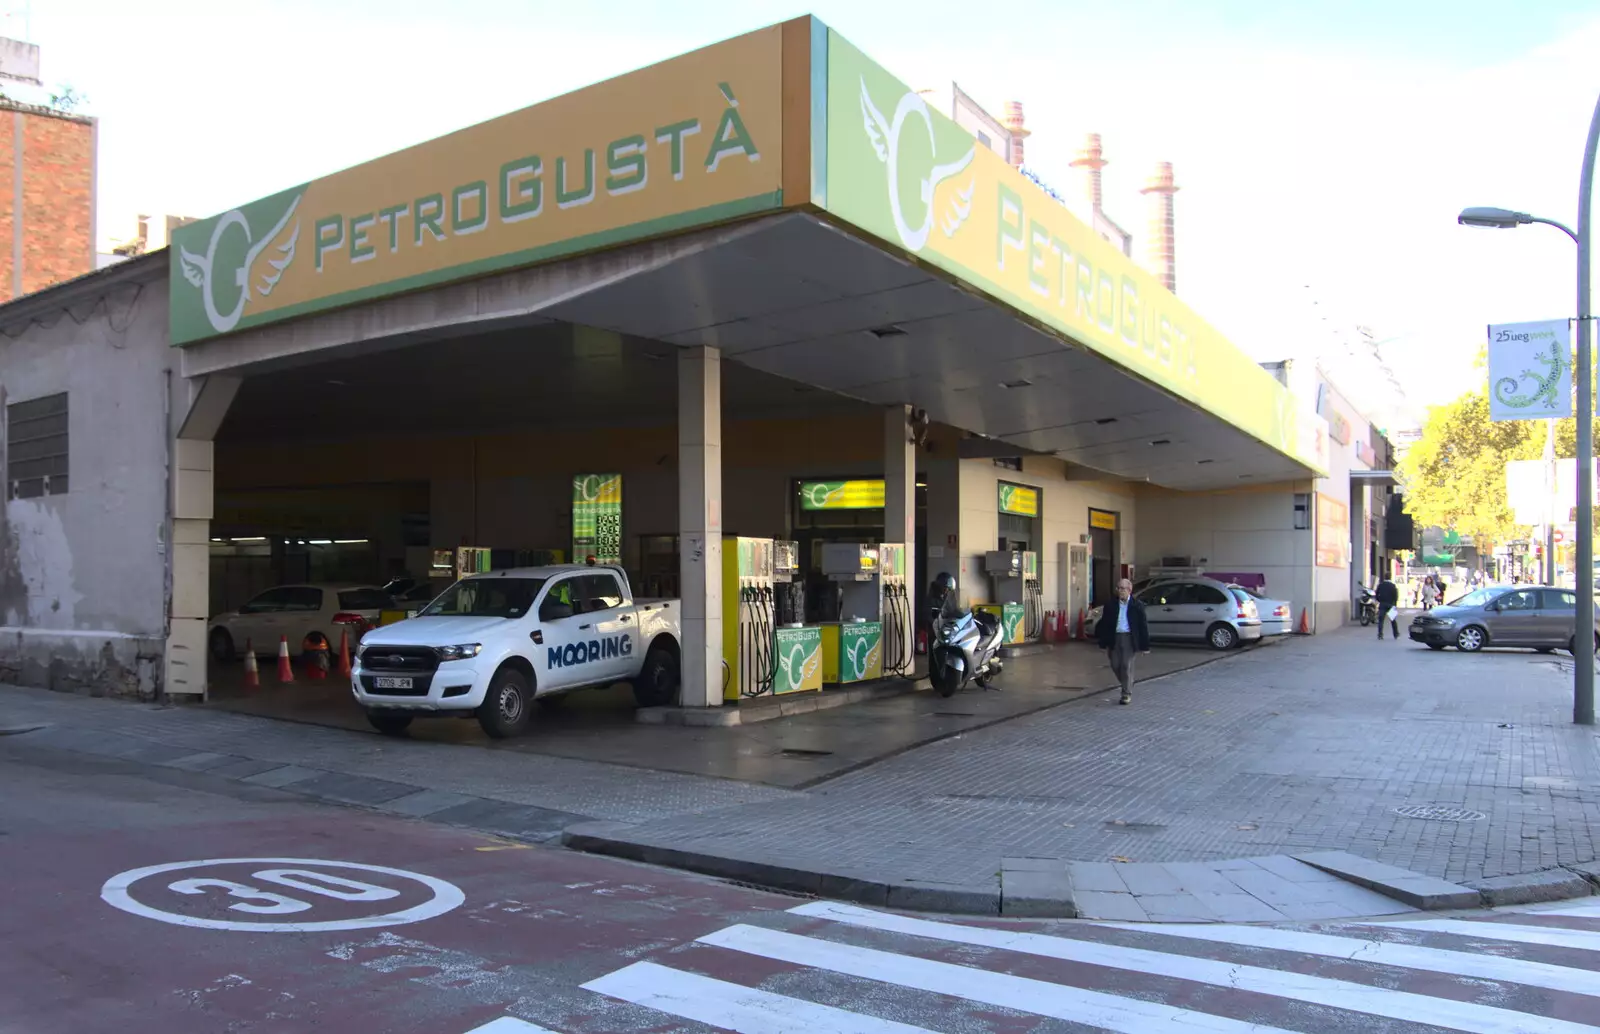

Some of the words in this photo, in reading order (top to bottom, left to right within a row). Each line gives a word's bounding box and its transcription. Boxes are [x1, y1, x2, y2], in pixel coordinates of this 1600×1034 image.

[314, 81, 761, 274] PETROGUSTÀ
[547, 633, 633, 670] MOORING
[168, 868, 400, 914] 30
